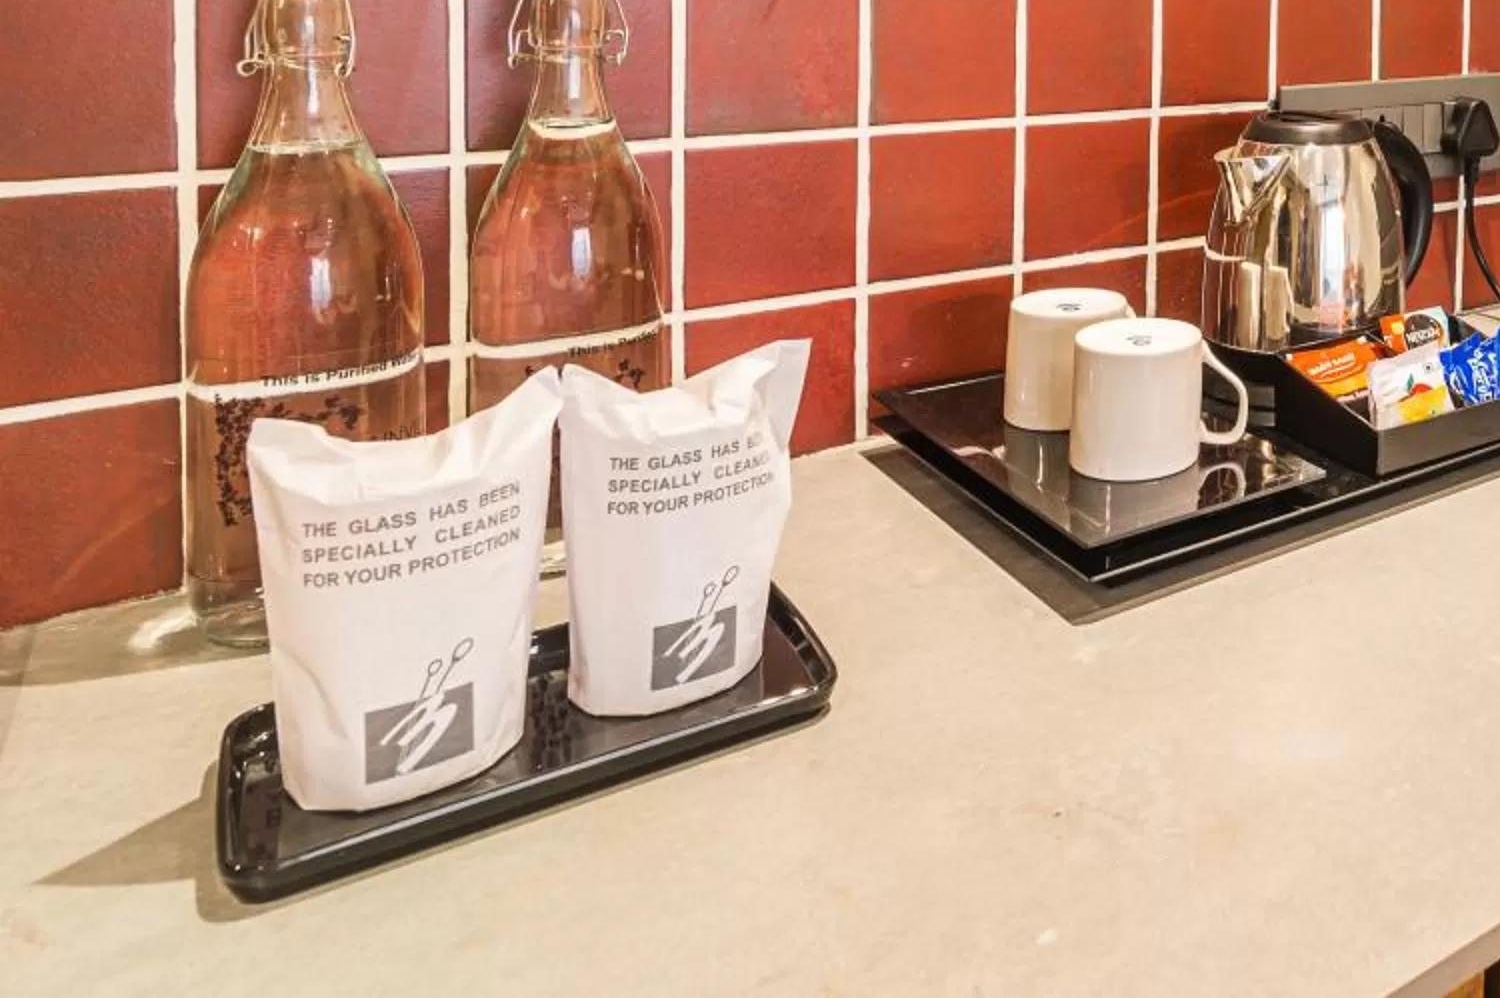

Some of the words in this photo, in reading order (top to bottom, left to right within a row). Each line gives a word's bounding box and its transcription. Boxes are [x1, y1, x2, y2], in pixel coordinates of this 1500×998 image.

[261, 374, 299, 387] This
[305, 373, 320, 384] is
[326, 359, 387, 382] Purified
[610, 457, 639, 470] THE
[647, 449, 703, 470] GLASS
[711, 440, 740, 458] HAS
[608, 471, 701, 493] SPECIALLY
[302, 521, 337, 538] THE
[348, 511, 417, 534] GLASS
[429, 499, 469, 522] HAS
[479, 481, 520, 508] BEEN
[607, 502, 639, 515] FOR
[643, 494, 689, 515] YOUR
[303, 535, 417, 563] SPECIALLY
[435, 505, 521, 544] CLEANED
[303, 572, 340, 588] FOR
[344, 563, 401, 586] YOUR
[408, 527, 521, 575] PROTECTION
